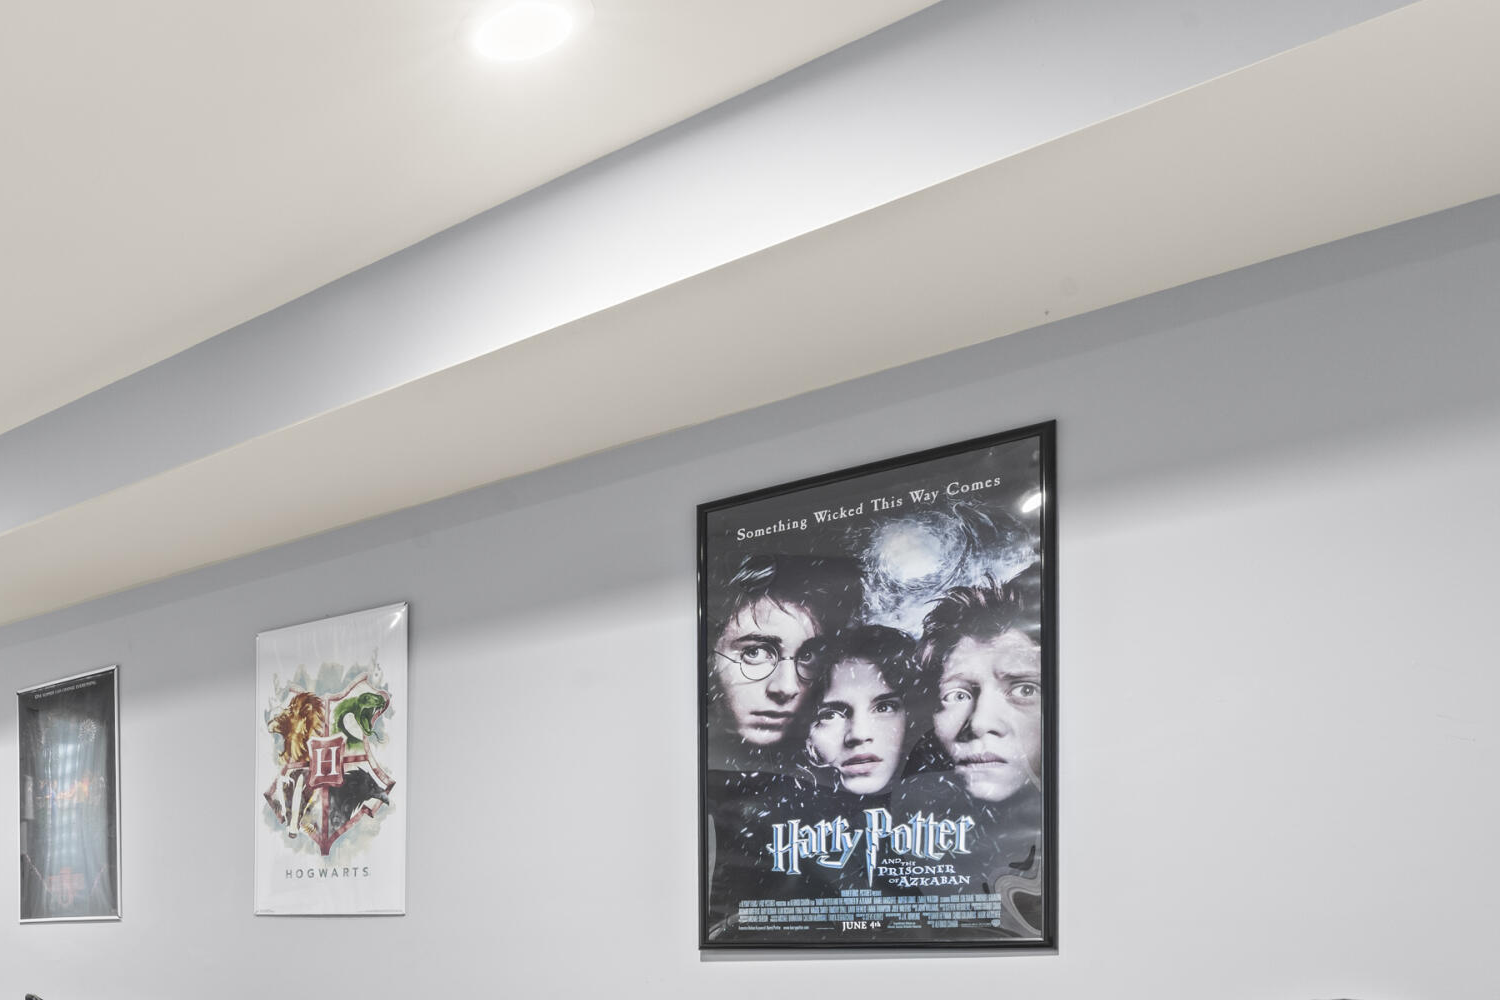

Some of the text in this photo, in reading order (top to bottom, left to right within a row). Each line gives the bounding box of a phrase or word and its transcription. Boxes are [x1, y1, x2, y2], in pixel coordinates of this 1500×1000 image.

[736, 477, 1001, 541] Something Wicked This Way Comes
[315, 746, 340, 777] H
[766, 807, 976, 888] Harry Potter
[881, 857, 902, 865] AND
[285, 866, 370, 879] HOGWARTS
[877, 864, 956, 877] PRISONER
[897, 875, 971, 888] AZKABAN
[842, 921, 867, 932] JUNE
